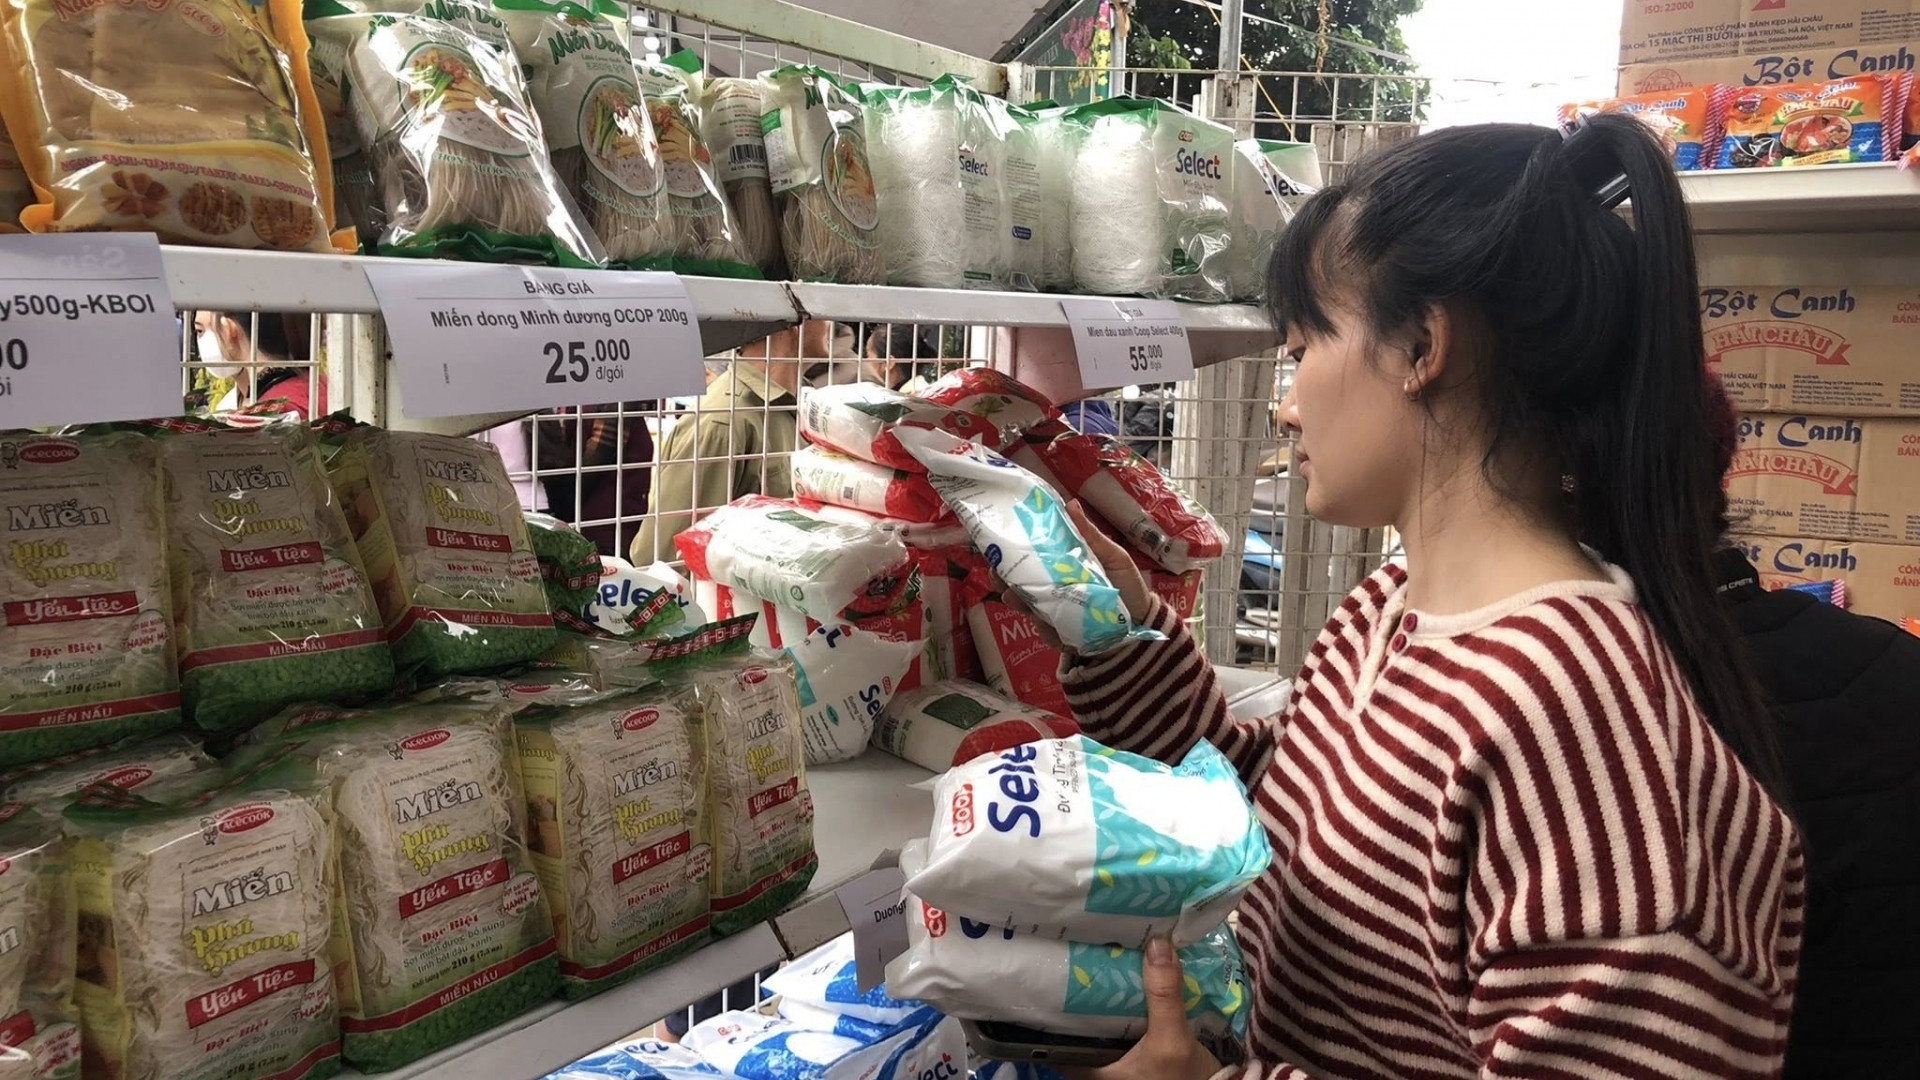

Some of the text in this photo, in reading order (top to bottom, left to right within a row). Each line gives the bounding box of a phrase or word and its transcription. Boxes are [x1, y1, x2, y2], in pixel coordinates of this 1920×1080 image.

[1664, 1, 1694, 12] 22000
[1648, 38, 1660, 47] 15
[1743, 46, 1916, 87] Bột Canh
[958, 155, 989, 177] Select
[1175, 147, 1222, 181] Select
[430, 307, 690, 330] Miến dong Minh dương OCOP 200g
[1700, 288, 1856, 319] Bột Canh
[1133, 326, 1150, 339] Coop
[1150, 326, 1169, 337] Select
[595, 364, 625, 384] đ/gói
[1737, 416, 1862, 447] ột Canh
[207, 464, 291, 493] Miến
[424, 459, 493, 485] Miến
[8, 498, 111, 532] Miến
[436, 529, 501, 551] Yến Tiệc
[230, 546, 311, 571] Yến Tiệc
[1773, 542, 1857, 574] Canh
[65, 684, 84, 696] 210
[747, 708, 788, 742] Miến
[612, 757, 678, 798] Miến
[395, 778, 484, 825] Miến
[621, 852, 650, 878] Yến
[192, 866, 295, 919] Miến
[412, 868, 496, 911] Yến Tiệc
[451, 955, 469, 971] 210
[201, 968, 297, 1018] Yến Tiệc
[439, 969, 500, 1007] MIẾN NẤU
